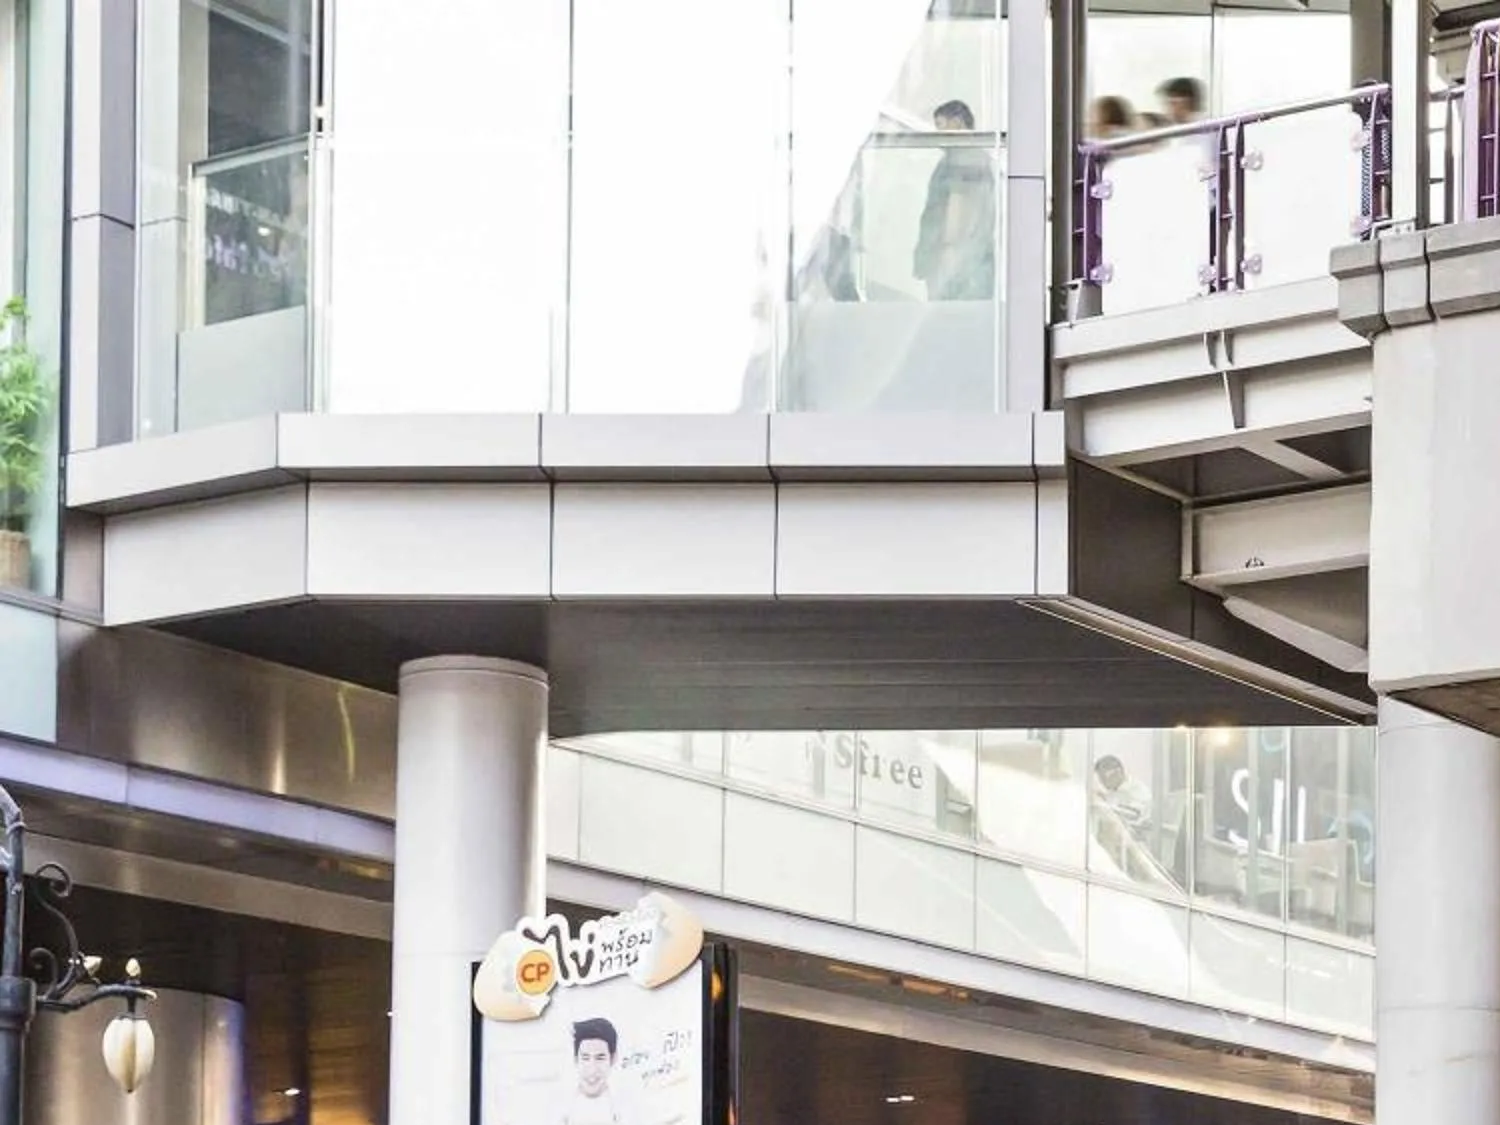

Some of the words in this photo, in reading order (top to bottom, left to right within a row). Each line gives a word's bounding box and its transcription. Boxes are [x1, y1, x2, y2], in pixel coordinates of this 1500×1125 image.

[522, 925, 596, 980] ไข่
[601, 927, 653, 954] พร้อม
[520, 962, 550, 983] CP
[600, 953, 639, 974] ทาน
